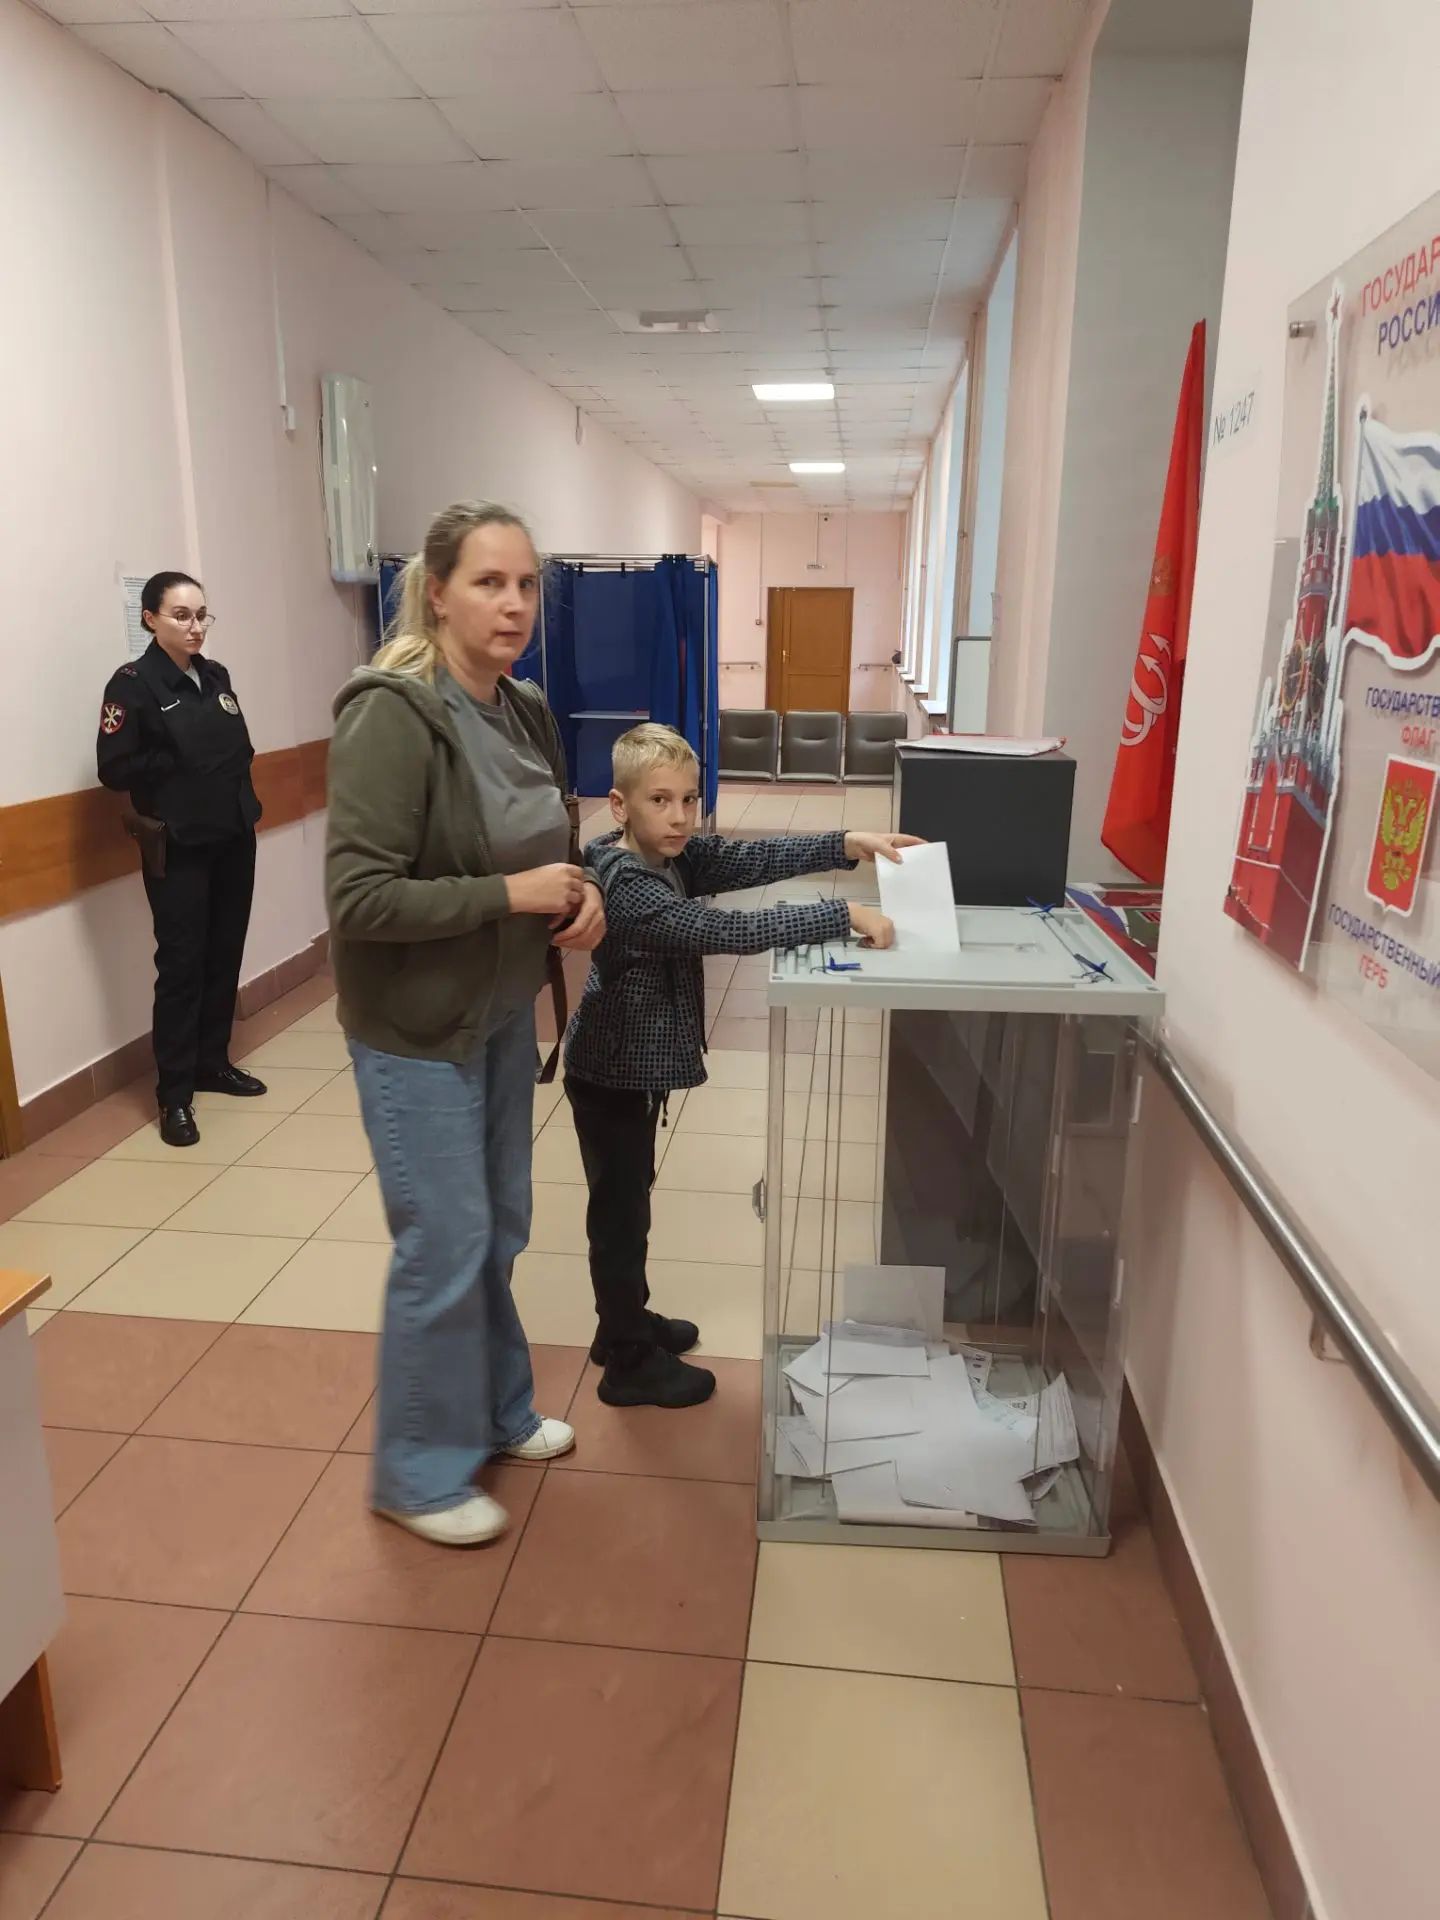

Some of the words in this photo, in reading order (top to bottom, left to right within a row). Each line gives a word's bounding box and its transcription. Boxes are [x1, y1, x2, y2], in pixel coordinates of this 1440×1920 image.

[1212, 415, 1226, 447] №
[1230, 391, 1255, 437] 1247
[1360, 954, 1388, 989] ГЕРБ
